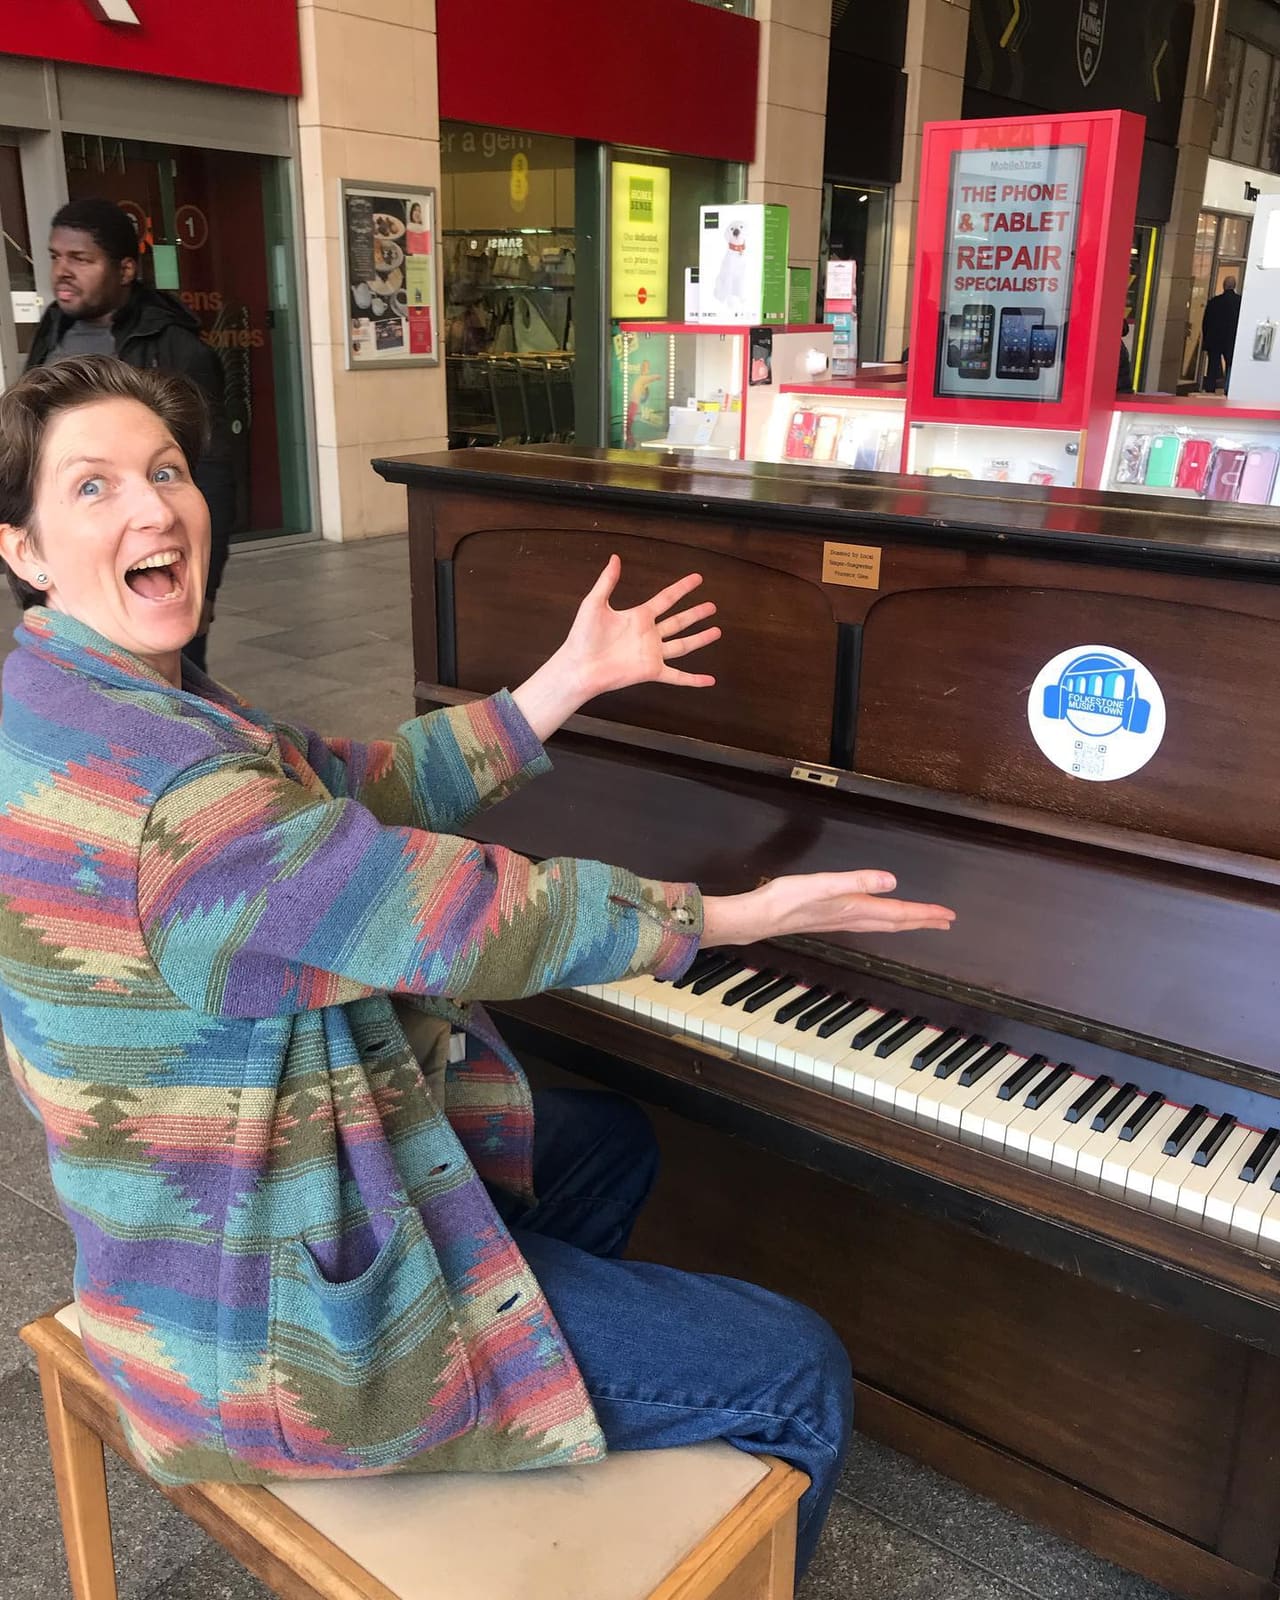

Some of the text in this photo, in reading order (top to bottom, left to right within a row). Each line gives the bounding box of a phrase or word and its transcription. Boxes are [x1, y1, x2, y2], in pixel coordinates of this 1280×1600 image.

[1081, 13, 1102, 37] KING
[463, 132, 476, 153] a
[990, 160, 1043, 170] MobileXtras
[961, 183, 1069, 203] THE PHONE
[185, 217, 195, 238] 1
[958, 211, 1070, 232] & TABLET
[956, 246, 1063, 270] REPAIR
[954, 276, 1059, 292] SPECIALISTS
[180, 291, 223, 311] ens
[200, 328, 265, 348] sories
[1069, 693, 1124, 708] FOLKESTONE
[1069, 700, 1123, 716] MUSIC TOWN
